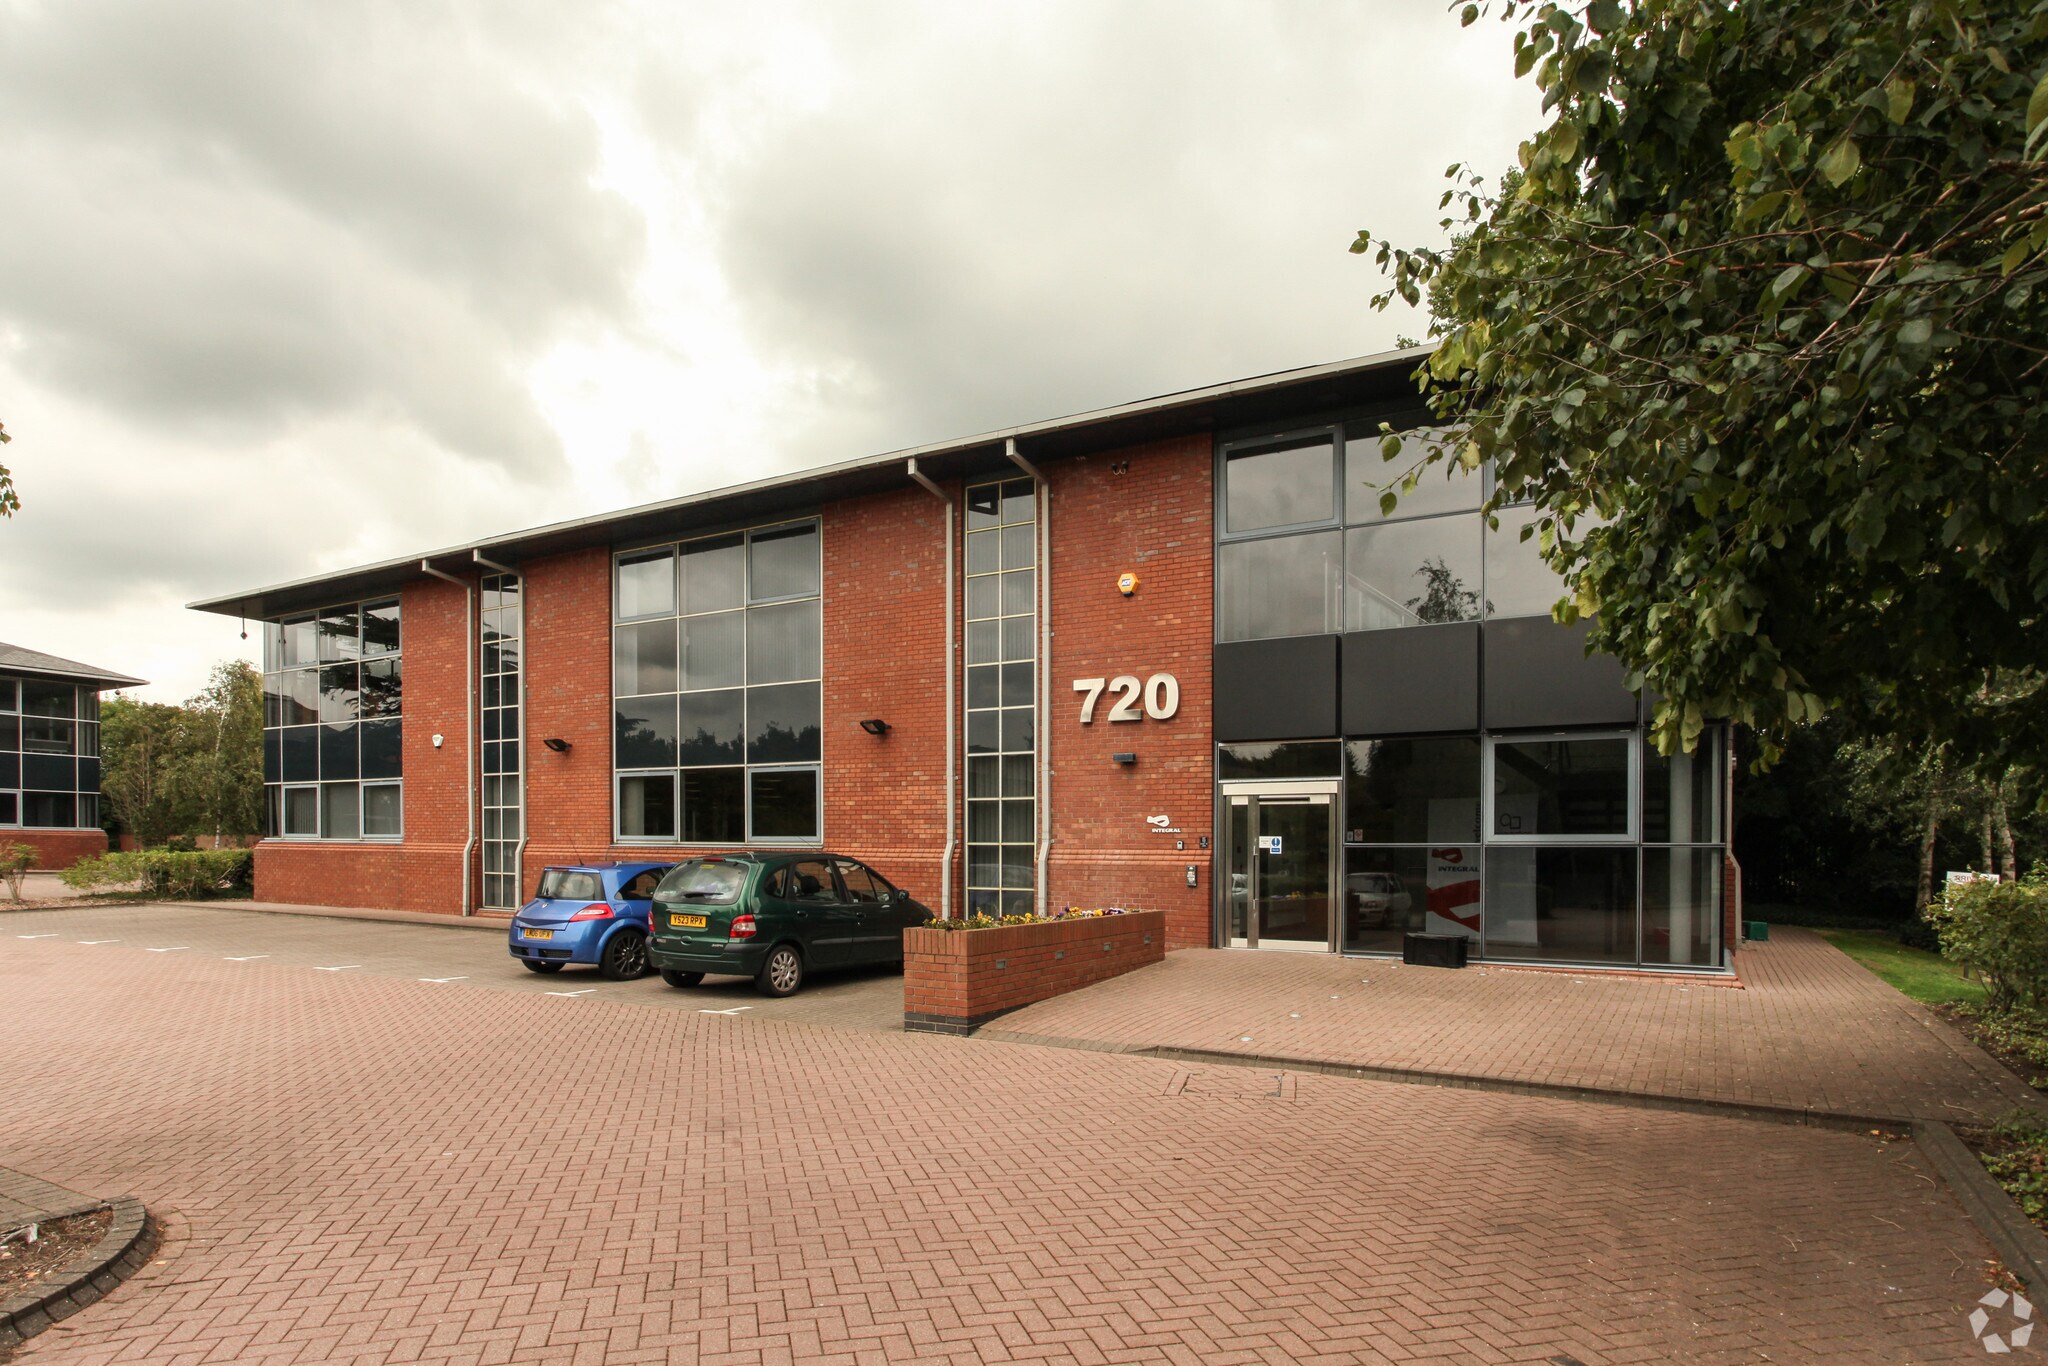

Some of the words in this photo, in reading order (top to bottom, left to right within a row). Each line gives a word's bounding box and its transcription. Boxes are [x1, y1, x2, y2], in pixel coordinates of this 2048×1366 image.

[1073, 673, 1179, 723] 720
[673, 915, 689, 925] Y523
[690, 916, 704, 926] RPX
